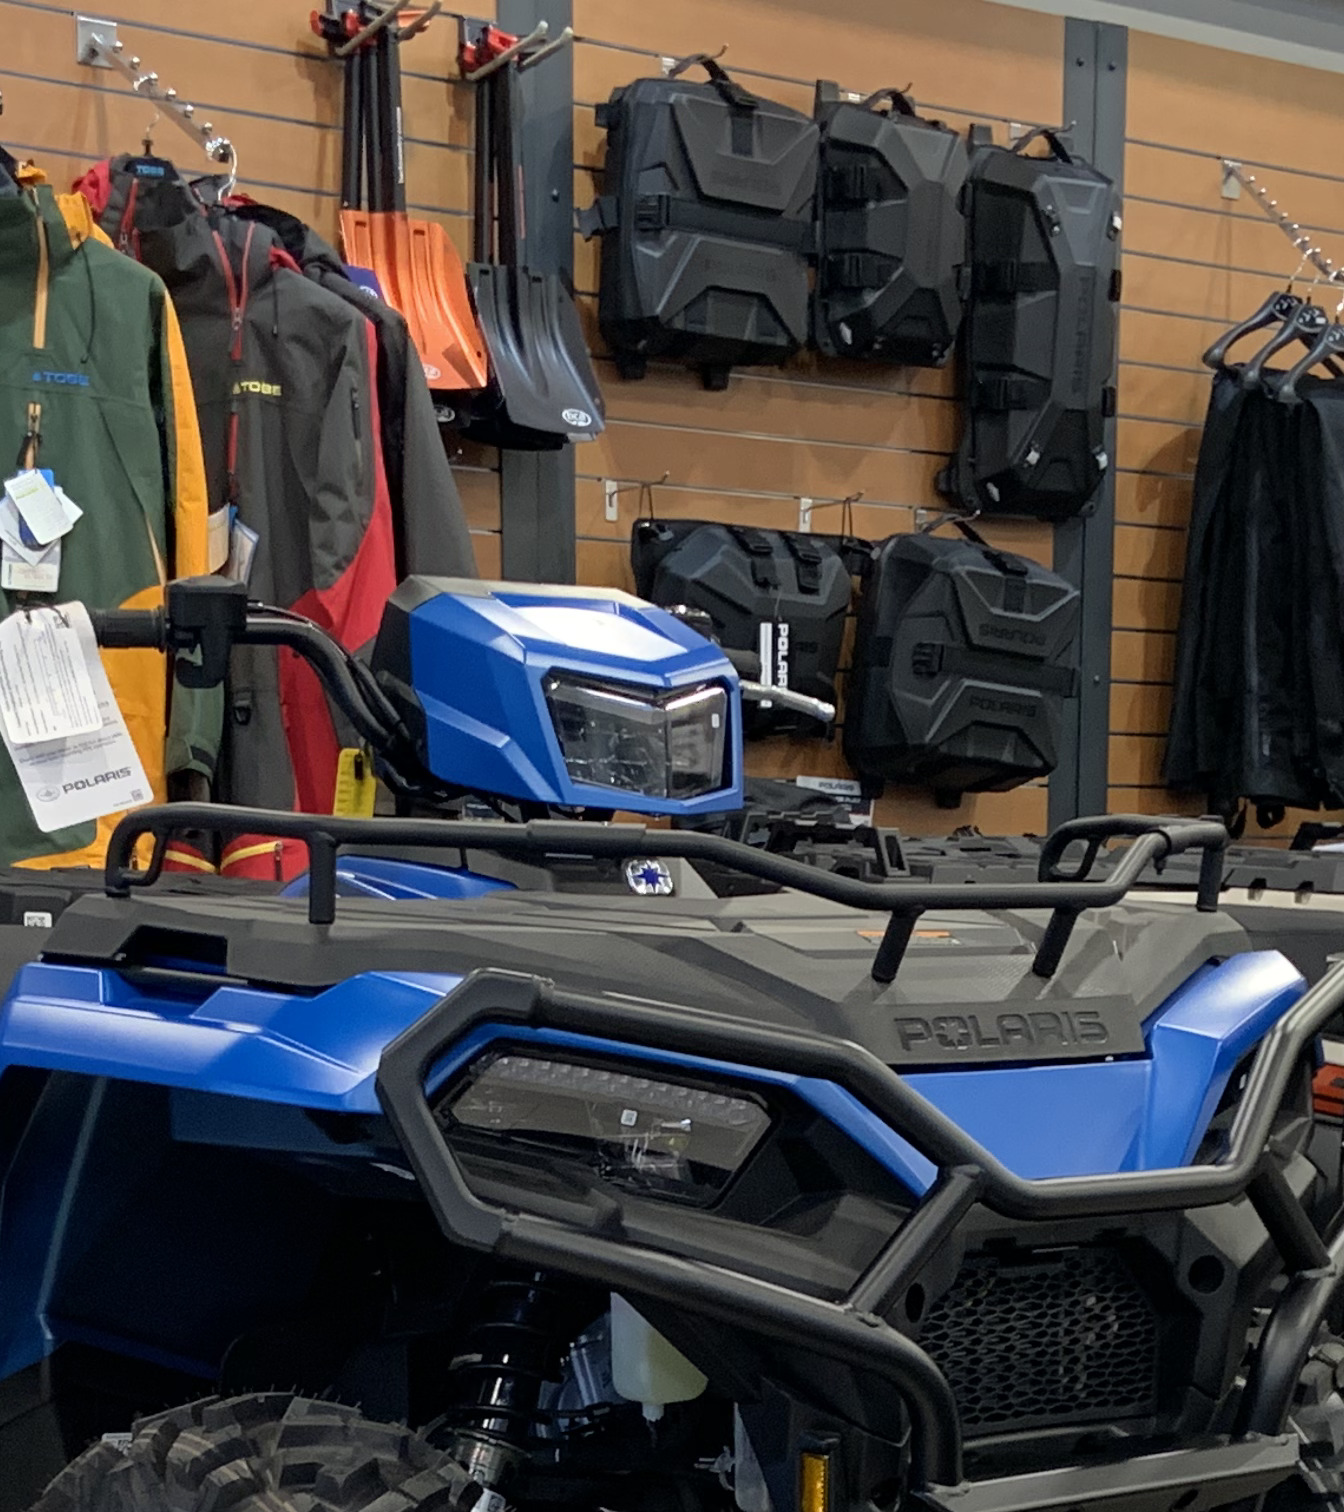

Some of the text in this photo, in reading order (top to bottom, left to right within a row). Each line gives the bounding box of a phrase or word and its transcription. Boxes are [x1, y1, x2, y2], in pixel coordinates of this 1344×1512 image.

[42, 370, 91, 387] TOBE
[240, 380, 282, 397] TOBE
[777, 623, 789, 689] POLAR
[62, 765, 133, 795] POLARIS
[892, 1010, 1110, 1051] POLARIS
